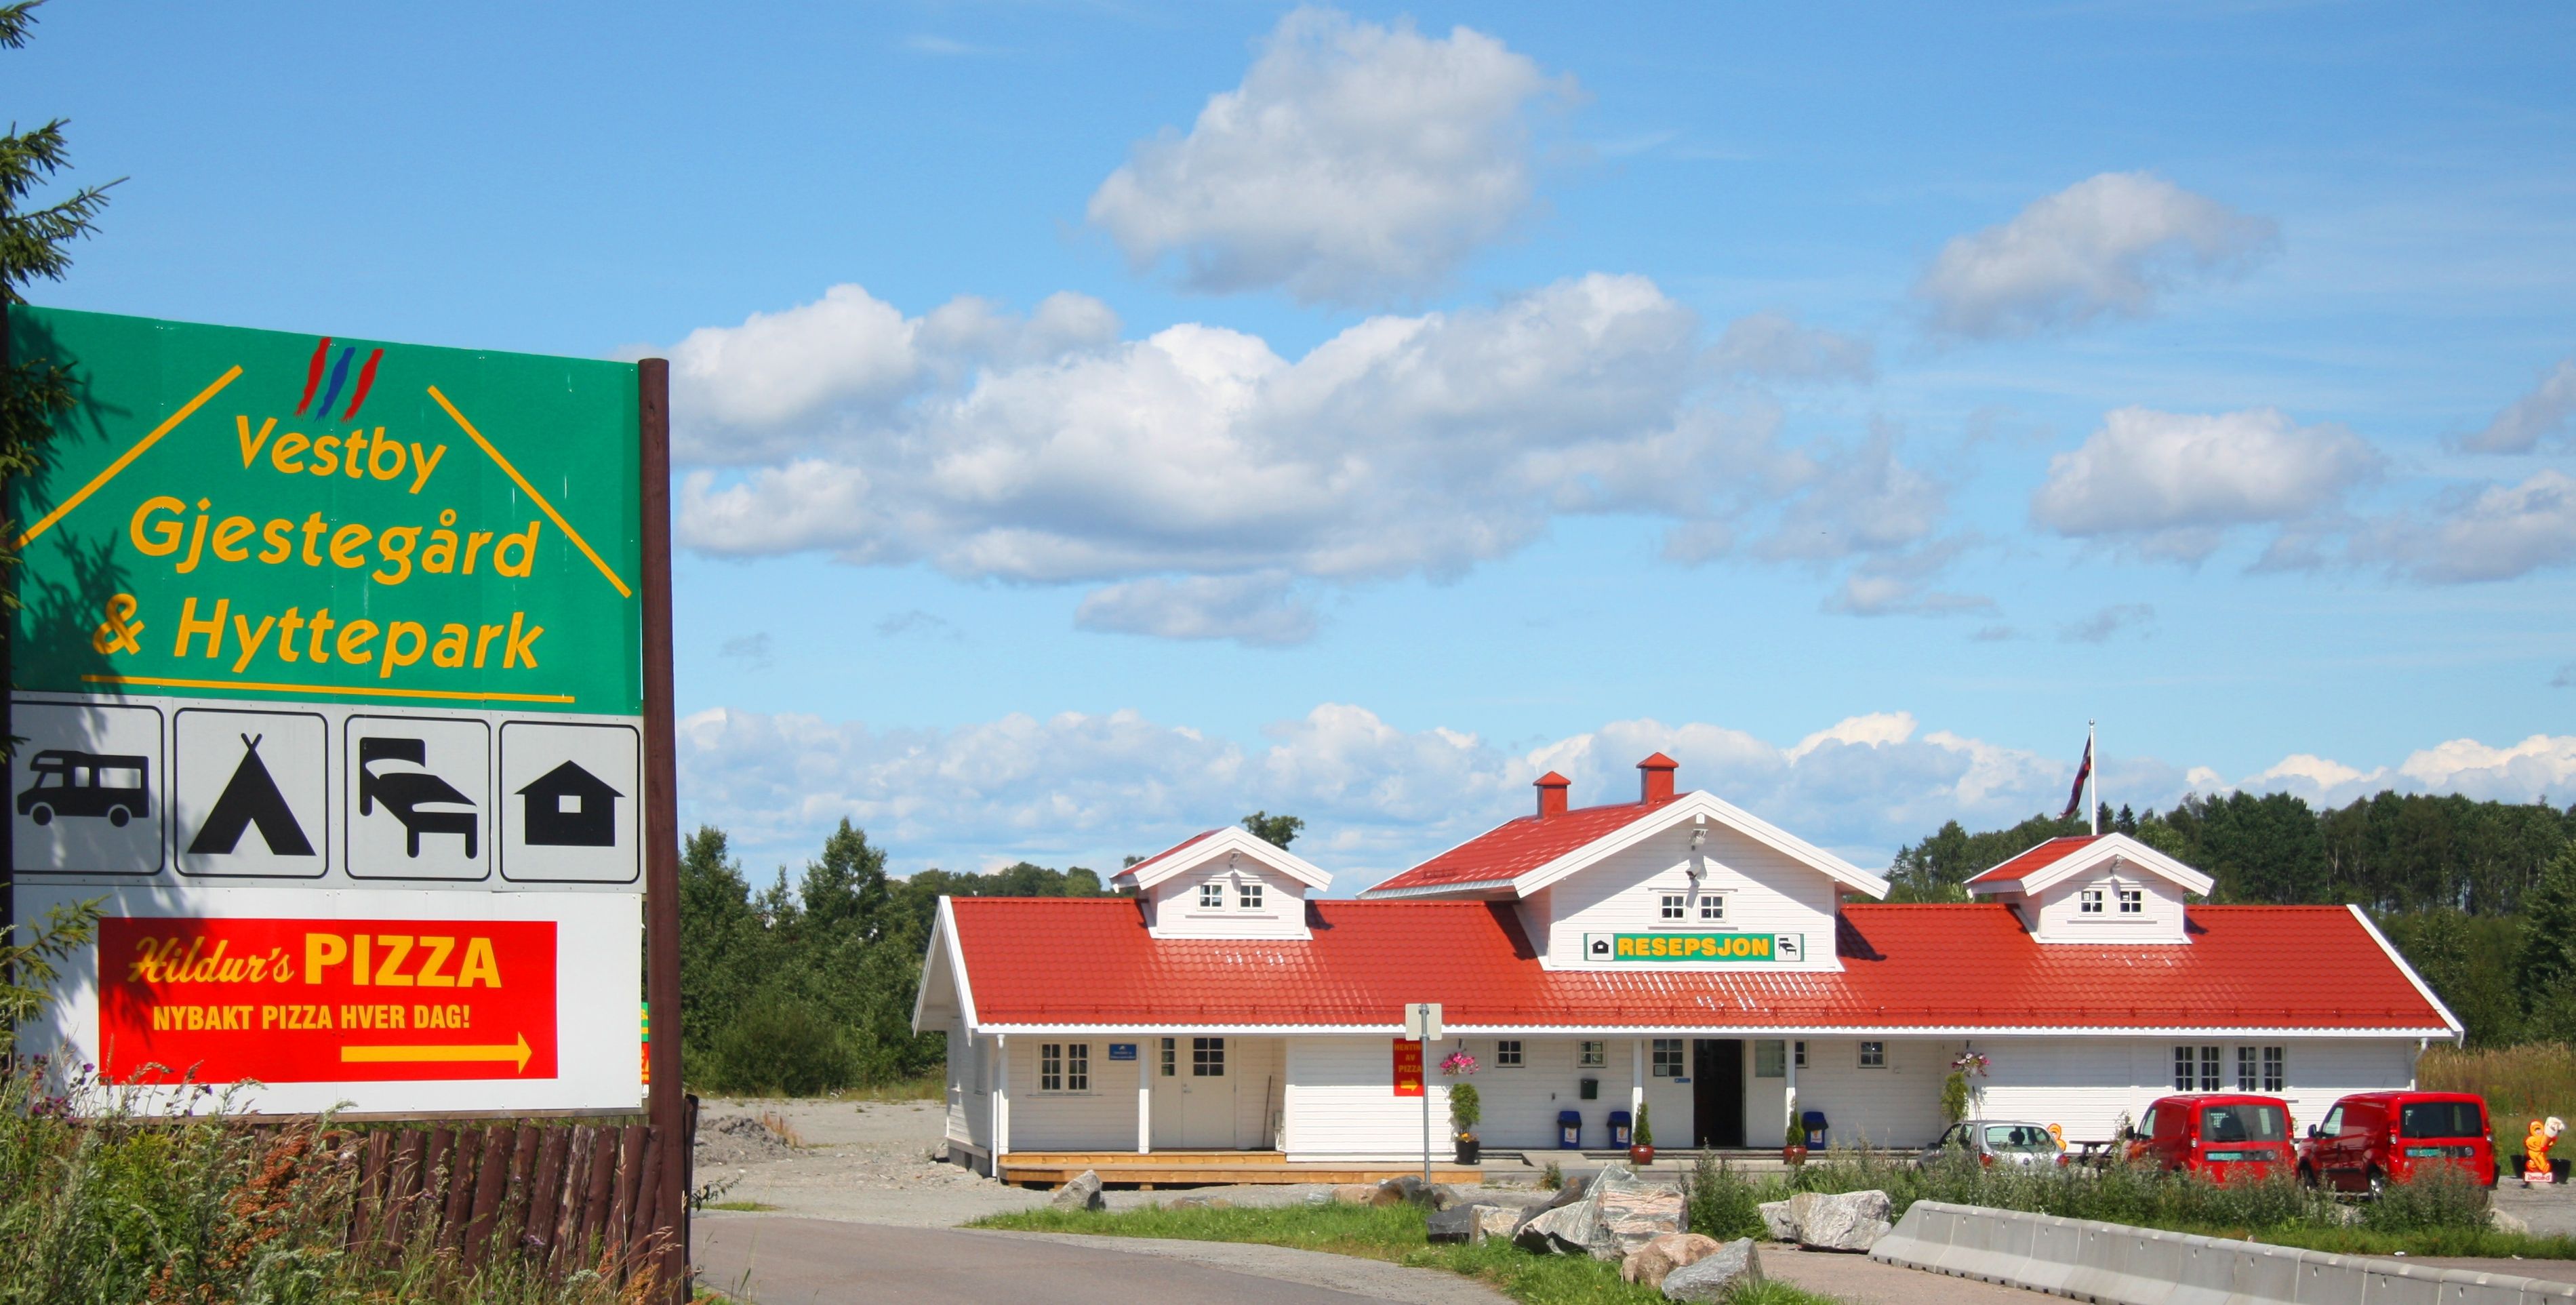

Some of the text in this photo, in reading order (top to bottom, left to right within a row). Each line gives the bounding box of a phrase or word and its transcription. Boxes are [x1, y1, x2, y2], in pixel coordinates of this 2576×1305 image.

[237, 415, 447, 494] Vestby
[129, 496, 541, 586] Gjestegård
[93, 593, 544, 679] & Hyttepark
[127, 933, 502, 988] Hildur's PIZZA
[1617, 938, 1769, 957] RESEPSJON
[153, 1004, 470, 1030] NYBAKT PIZZA HVER DAG!
